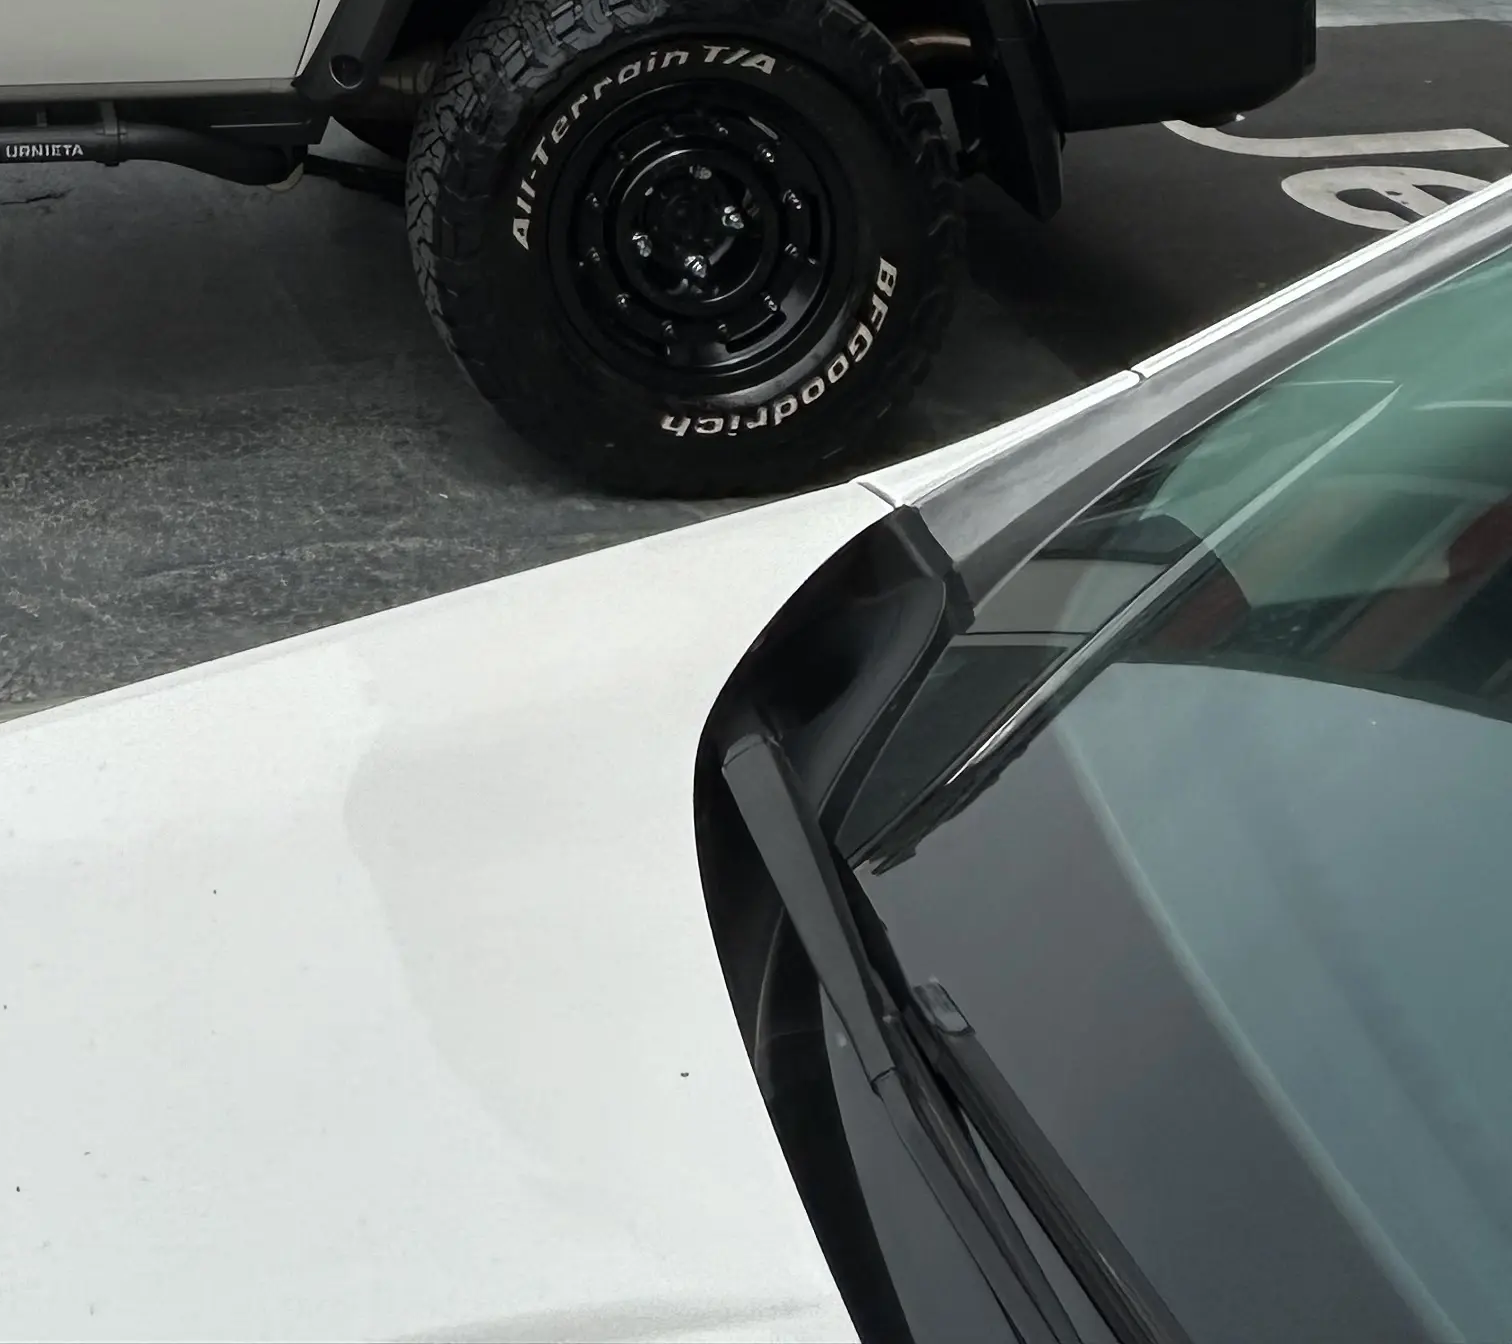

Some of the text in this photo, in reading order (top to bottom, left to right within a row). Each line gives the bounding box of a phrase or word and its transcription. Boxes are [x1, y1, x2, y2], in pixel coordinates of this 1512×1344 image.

[511, 44, 778, 251] All-Terrain T/A
[659, 256, 898, 437] BFGoodrich
